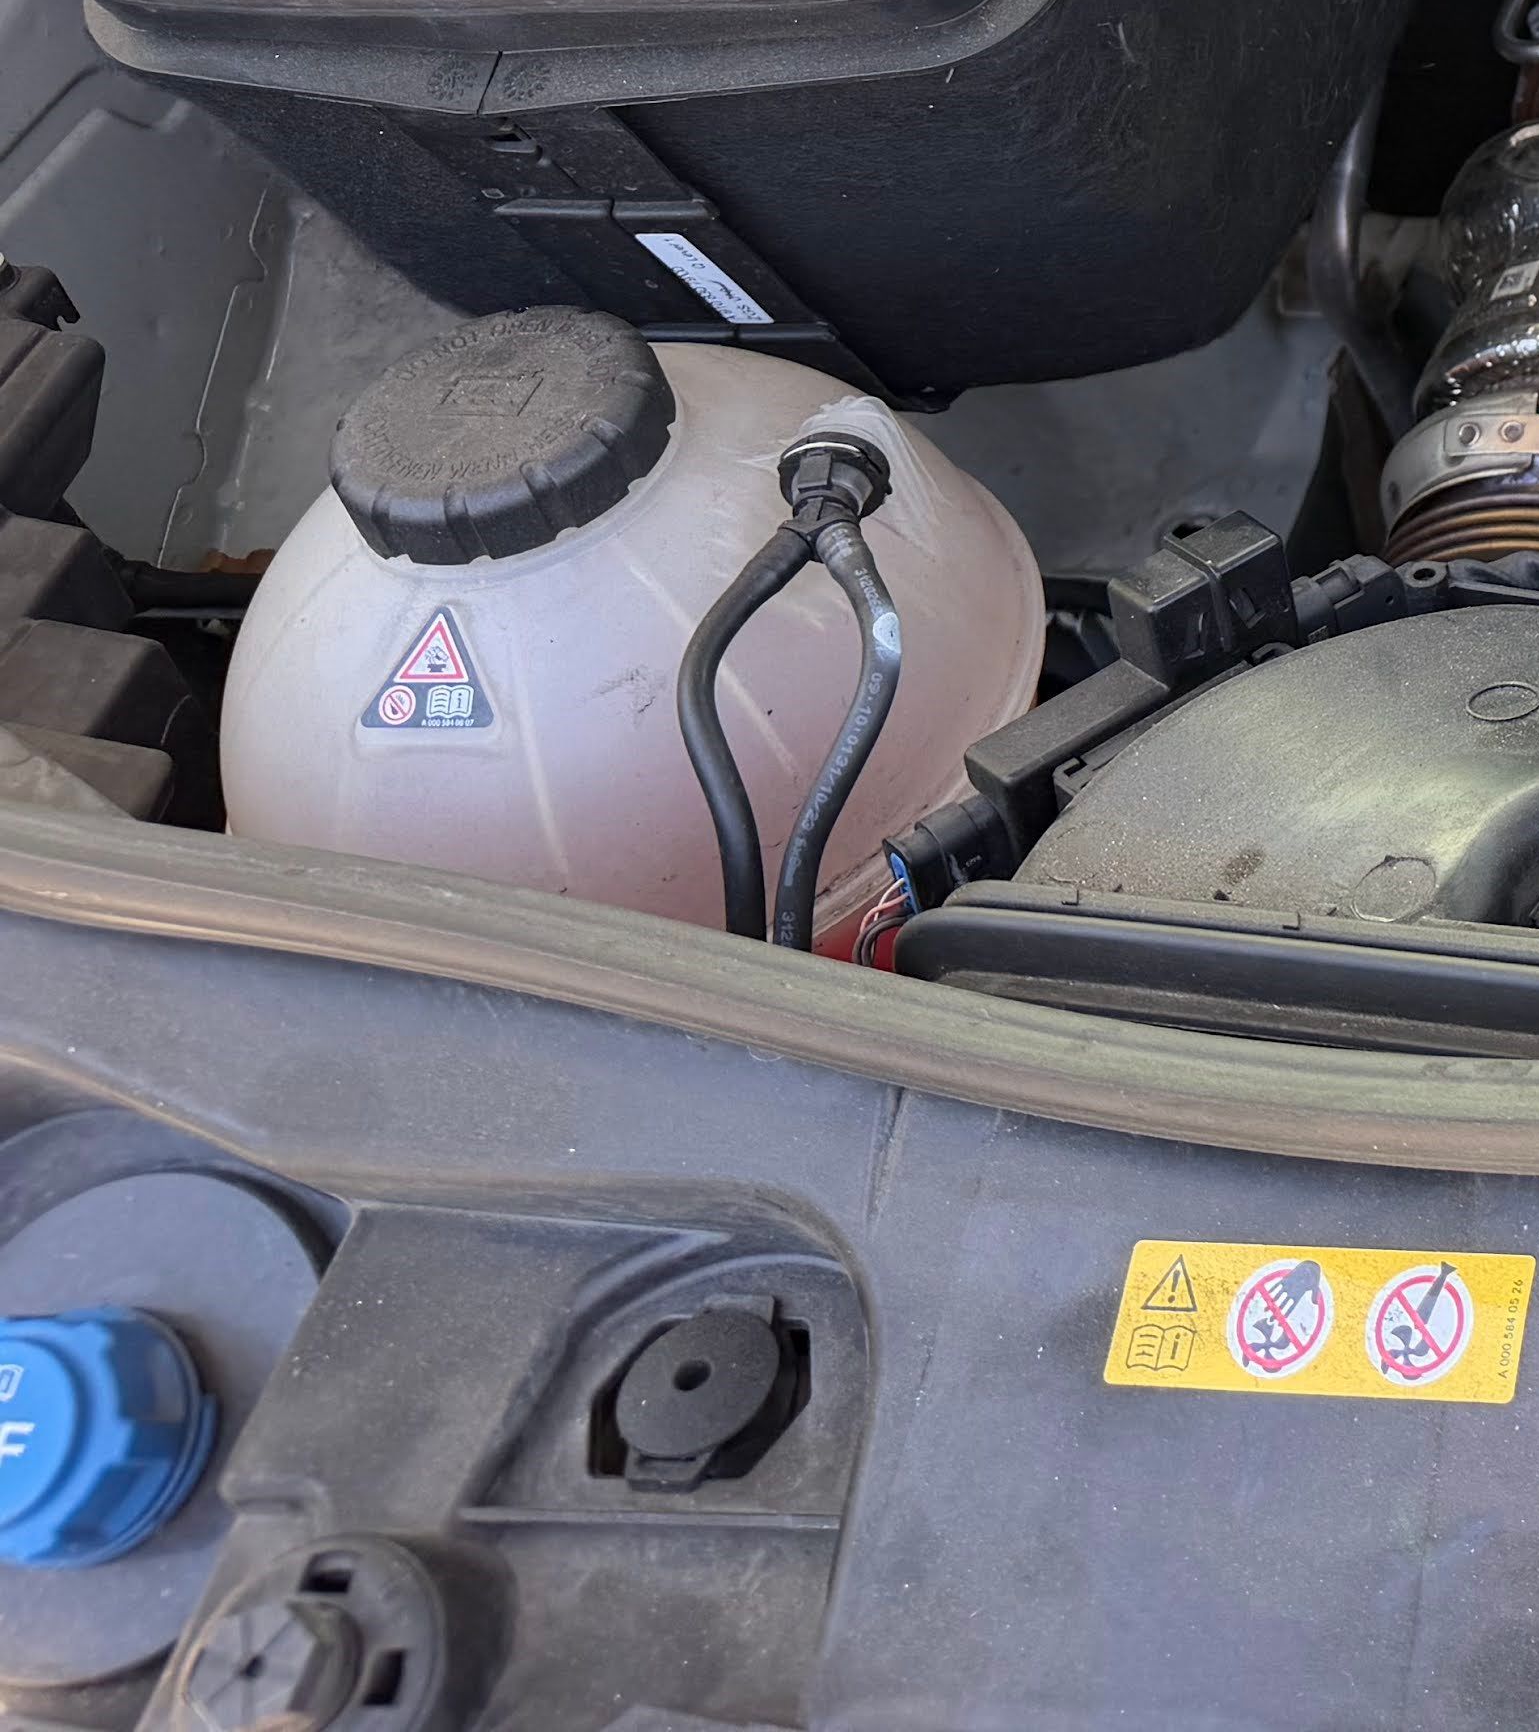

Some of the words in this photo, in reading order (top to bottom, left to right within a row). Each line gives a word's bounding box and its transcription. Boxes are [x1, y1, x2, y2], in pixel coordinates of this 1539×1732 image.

[1512, 1279, 1523, 1293] 26
[1508, 1298, 1520, 1313] 05
[1504, 1317, 1515, 1339] 584
[1500, 1343, 1512, 1366] 000
[1498, 1370, 1508, 1379] A
